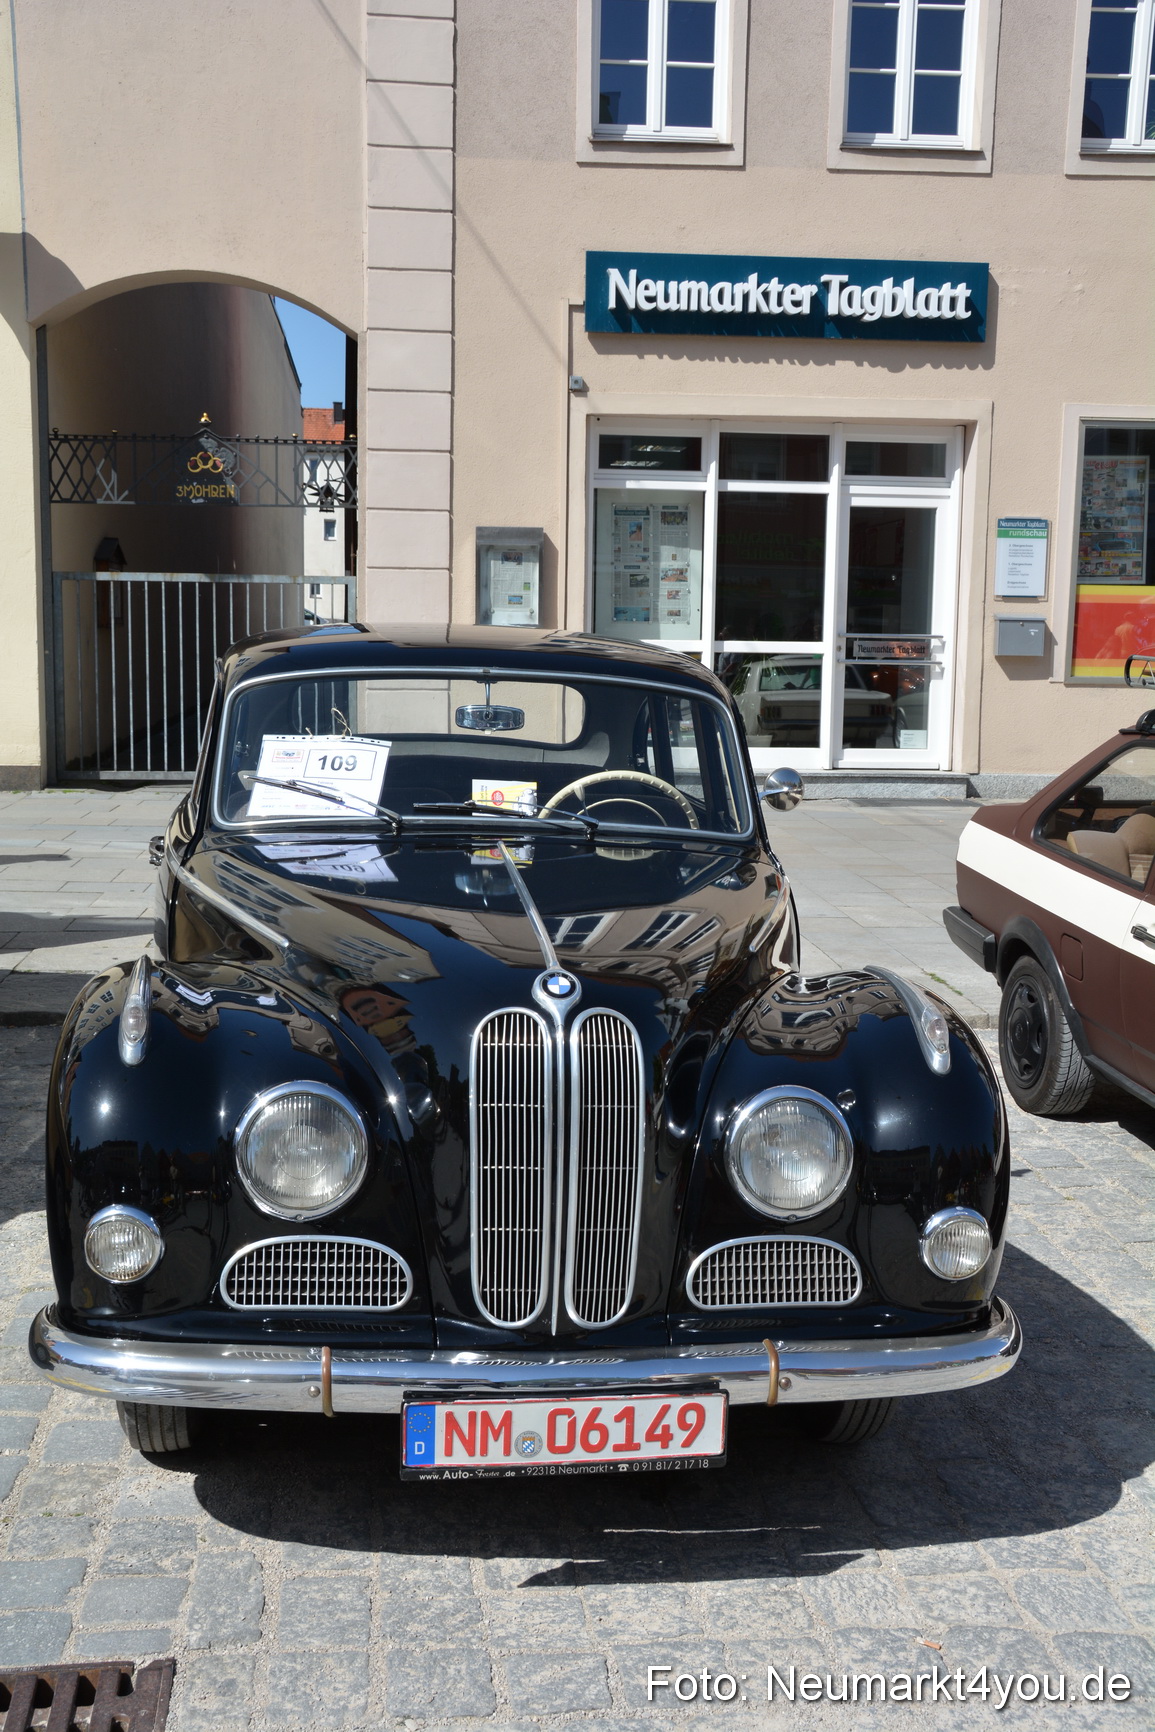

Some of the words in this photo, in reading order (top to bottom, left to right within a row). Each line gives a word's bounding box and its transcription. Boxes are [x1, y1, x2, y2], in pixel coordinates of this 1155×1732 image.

[606, 267, 818, 317] Neumarkter
[820, 273, 972, 323] Tagblatt
[857, 644, 895, 654] Neumarkter
[897, 645, 926, 655] Tagblatt
[317, 754, 358, 772] 109
[544, 972, 574, 981] BMW
[414, 1441, 426, 1456] D
[444, 1409, 512, 1458] NM
[546, 1402, 706, 1455] 06149
[527, 1465, 556, 1476] 92318
[558, 1463, 608, 1475] Neumarkt
